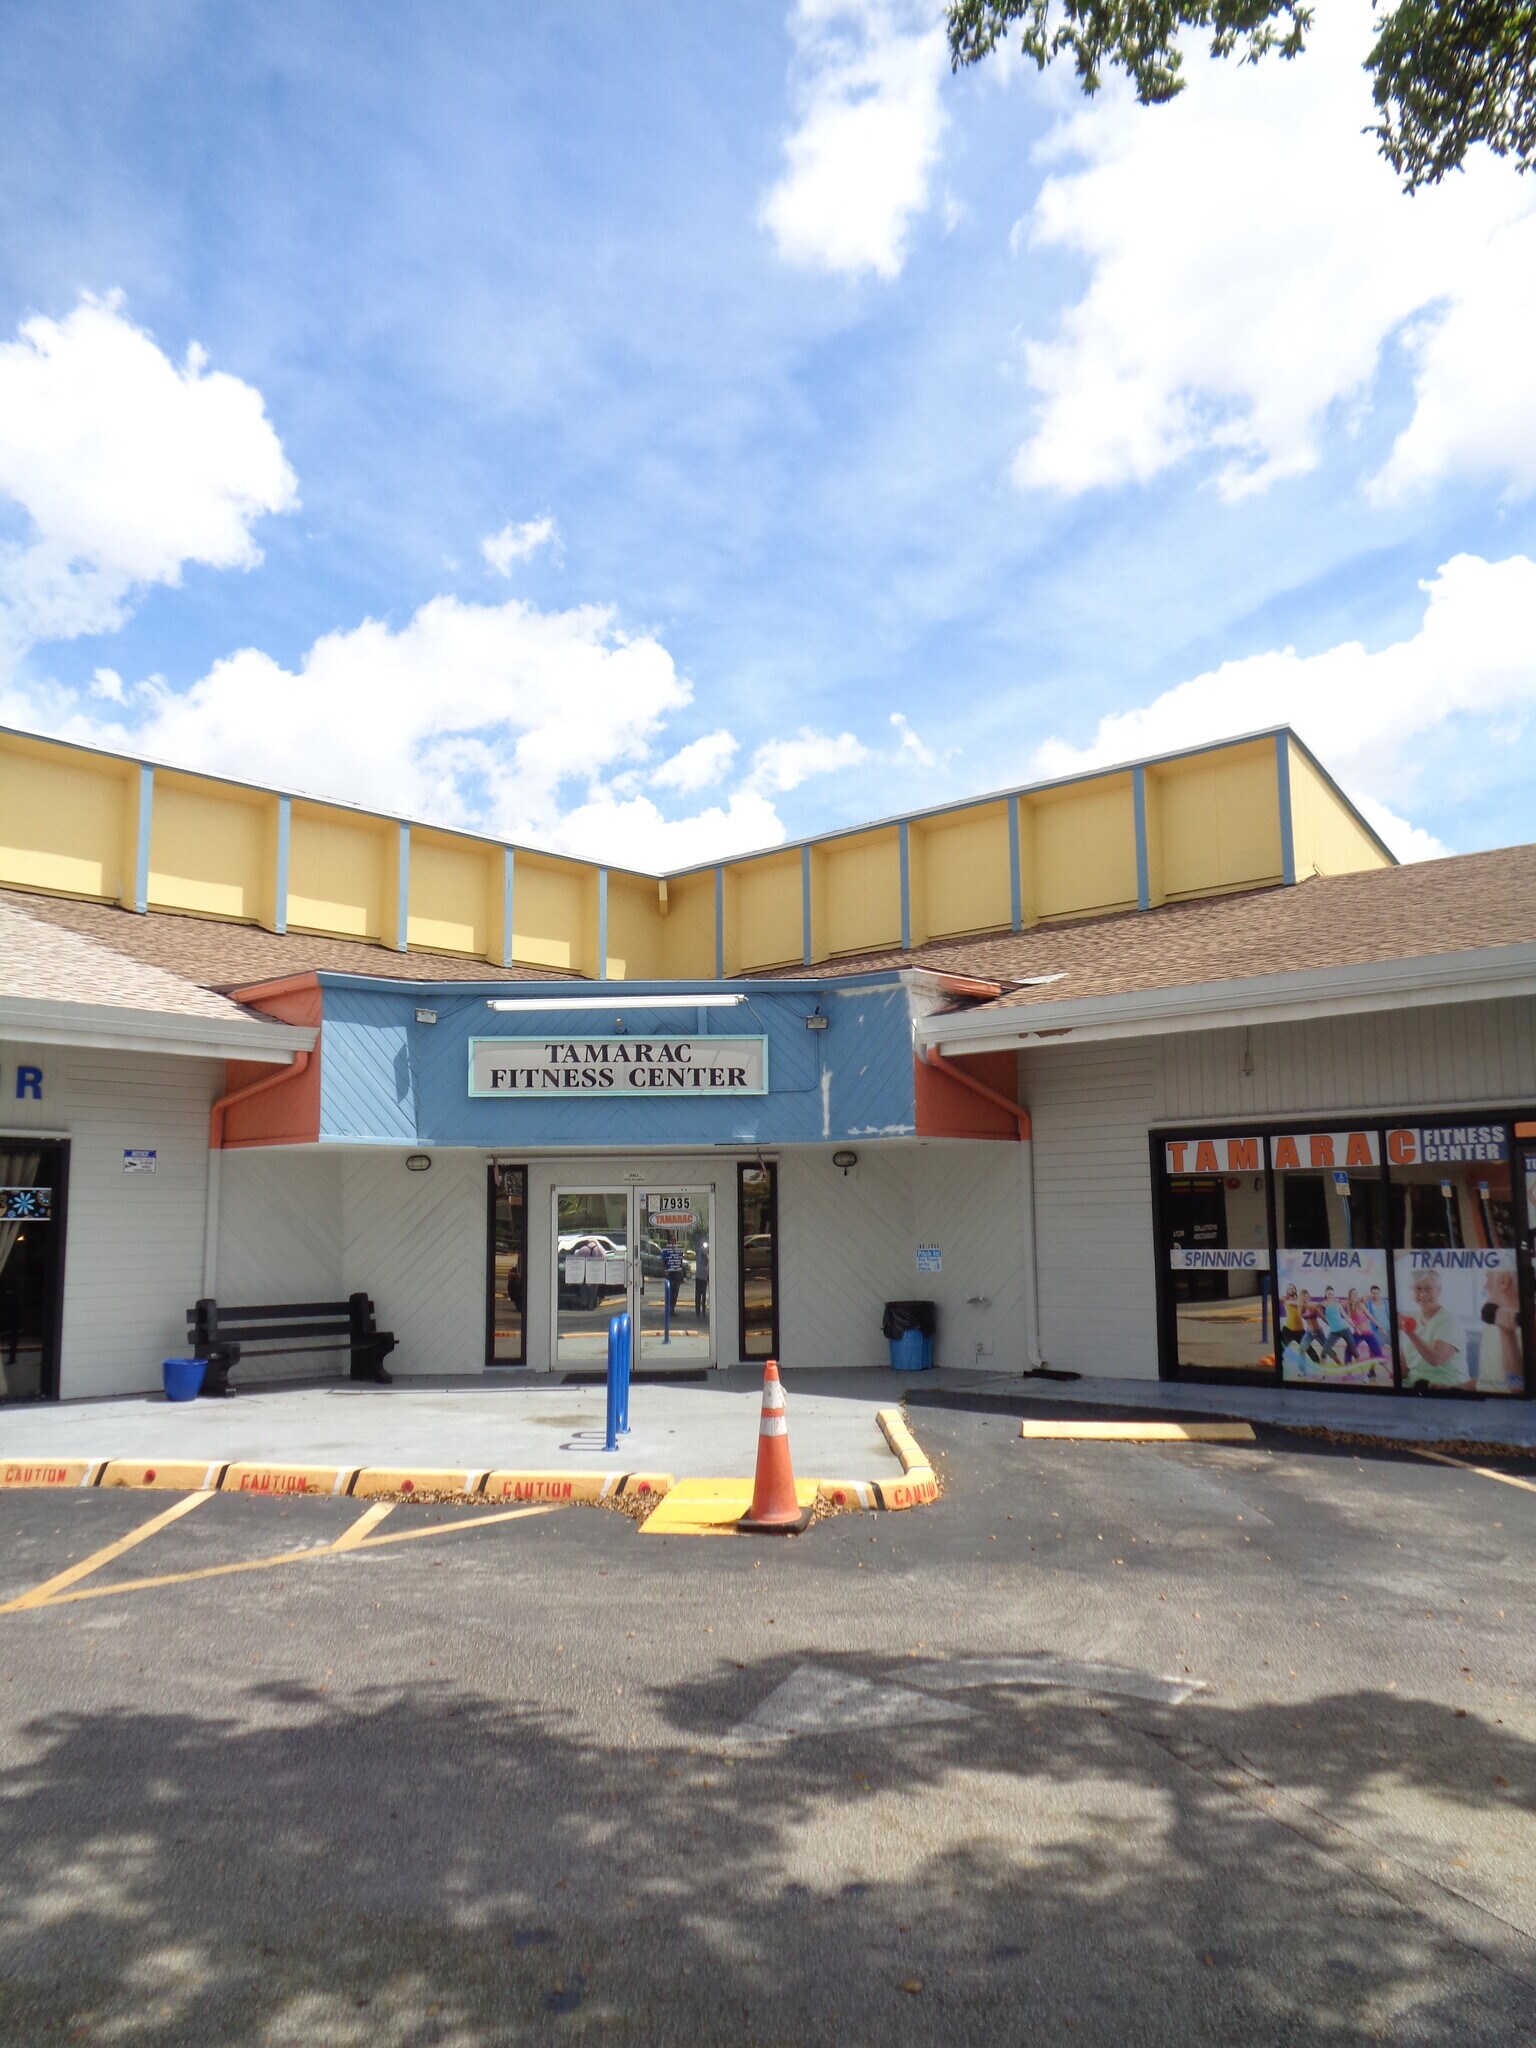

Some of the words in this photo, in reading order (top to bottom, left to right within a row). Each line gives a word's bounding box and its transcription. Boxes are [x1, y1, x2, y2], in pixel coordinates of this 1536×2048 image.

[545, 1043, 691, 1063] TAMARAC
[490, 1068, 614, 1088] FITNESS
[628, 1067, 748, 1087] CENTER
[1423, 1126, 1505, 1145] FITNESS
[1167, 1130, 1417, 1172] TAMARAC
[1424, 1143, 1500, 1162] CENTER
[663, 1197, 690, 1209] 7935
[655, 1214, 693, 1224] TAMARAC
[1184, 1251, 1257, 1268] SPINNING
[1302, 1251, 1362, 1268] ZUMBA
[1410, 1251, 1500, 1268] TRAINING
[5, 1468, 67, 1483] CAUTION
[240, 1474, 307, 1491] CAUTION
[503, 1481, 572, 1498] CAUTION
